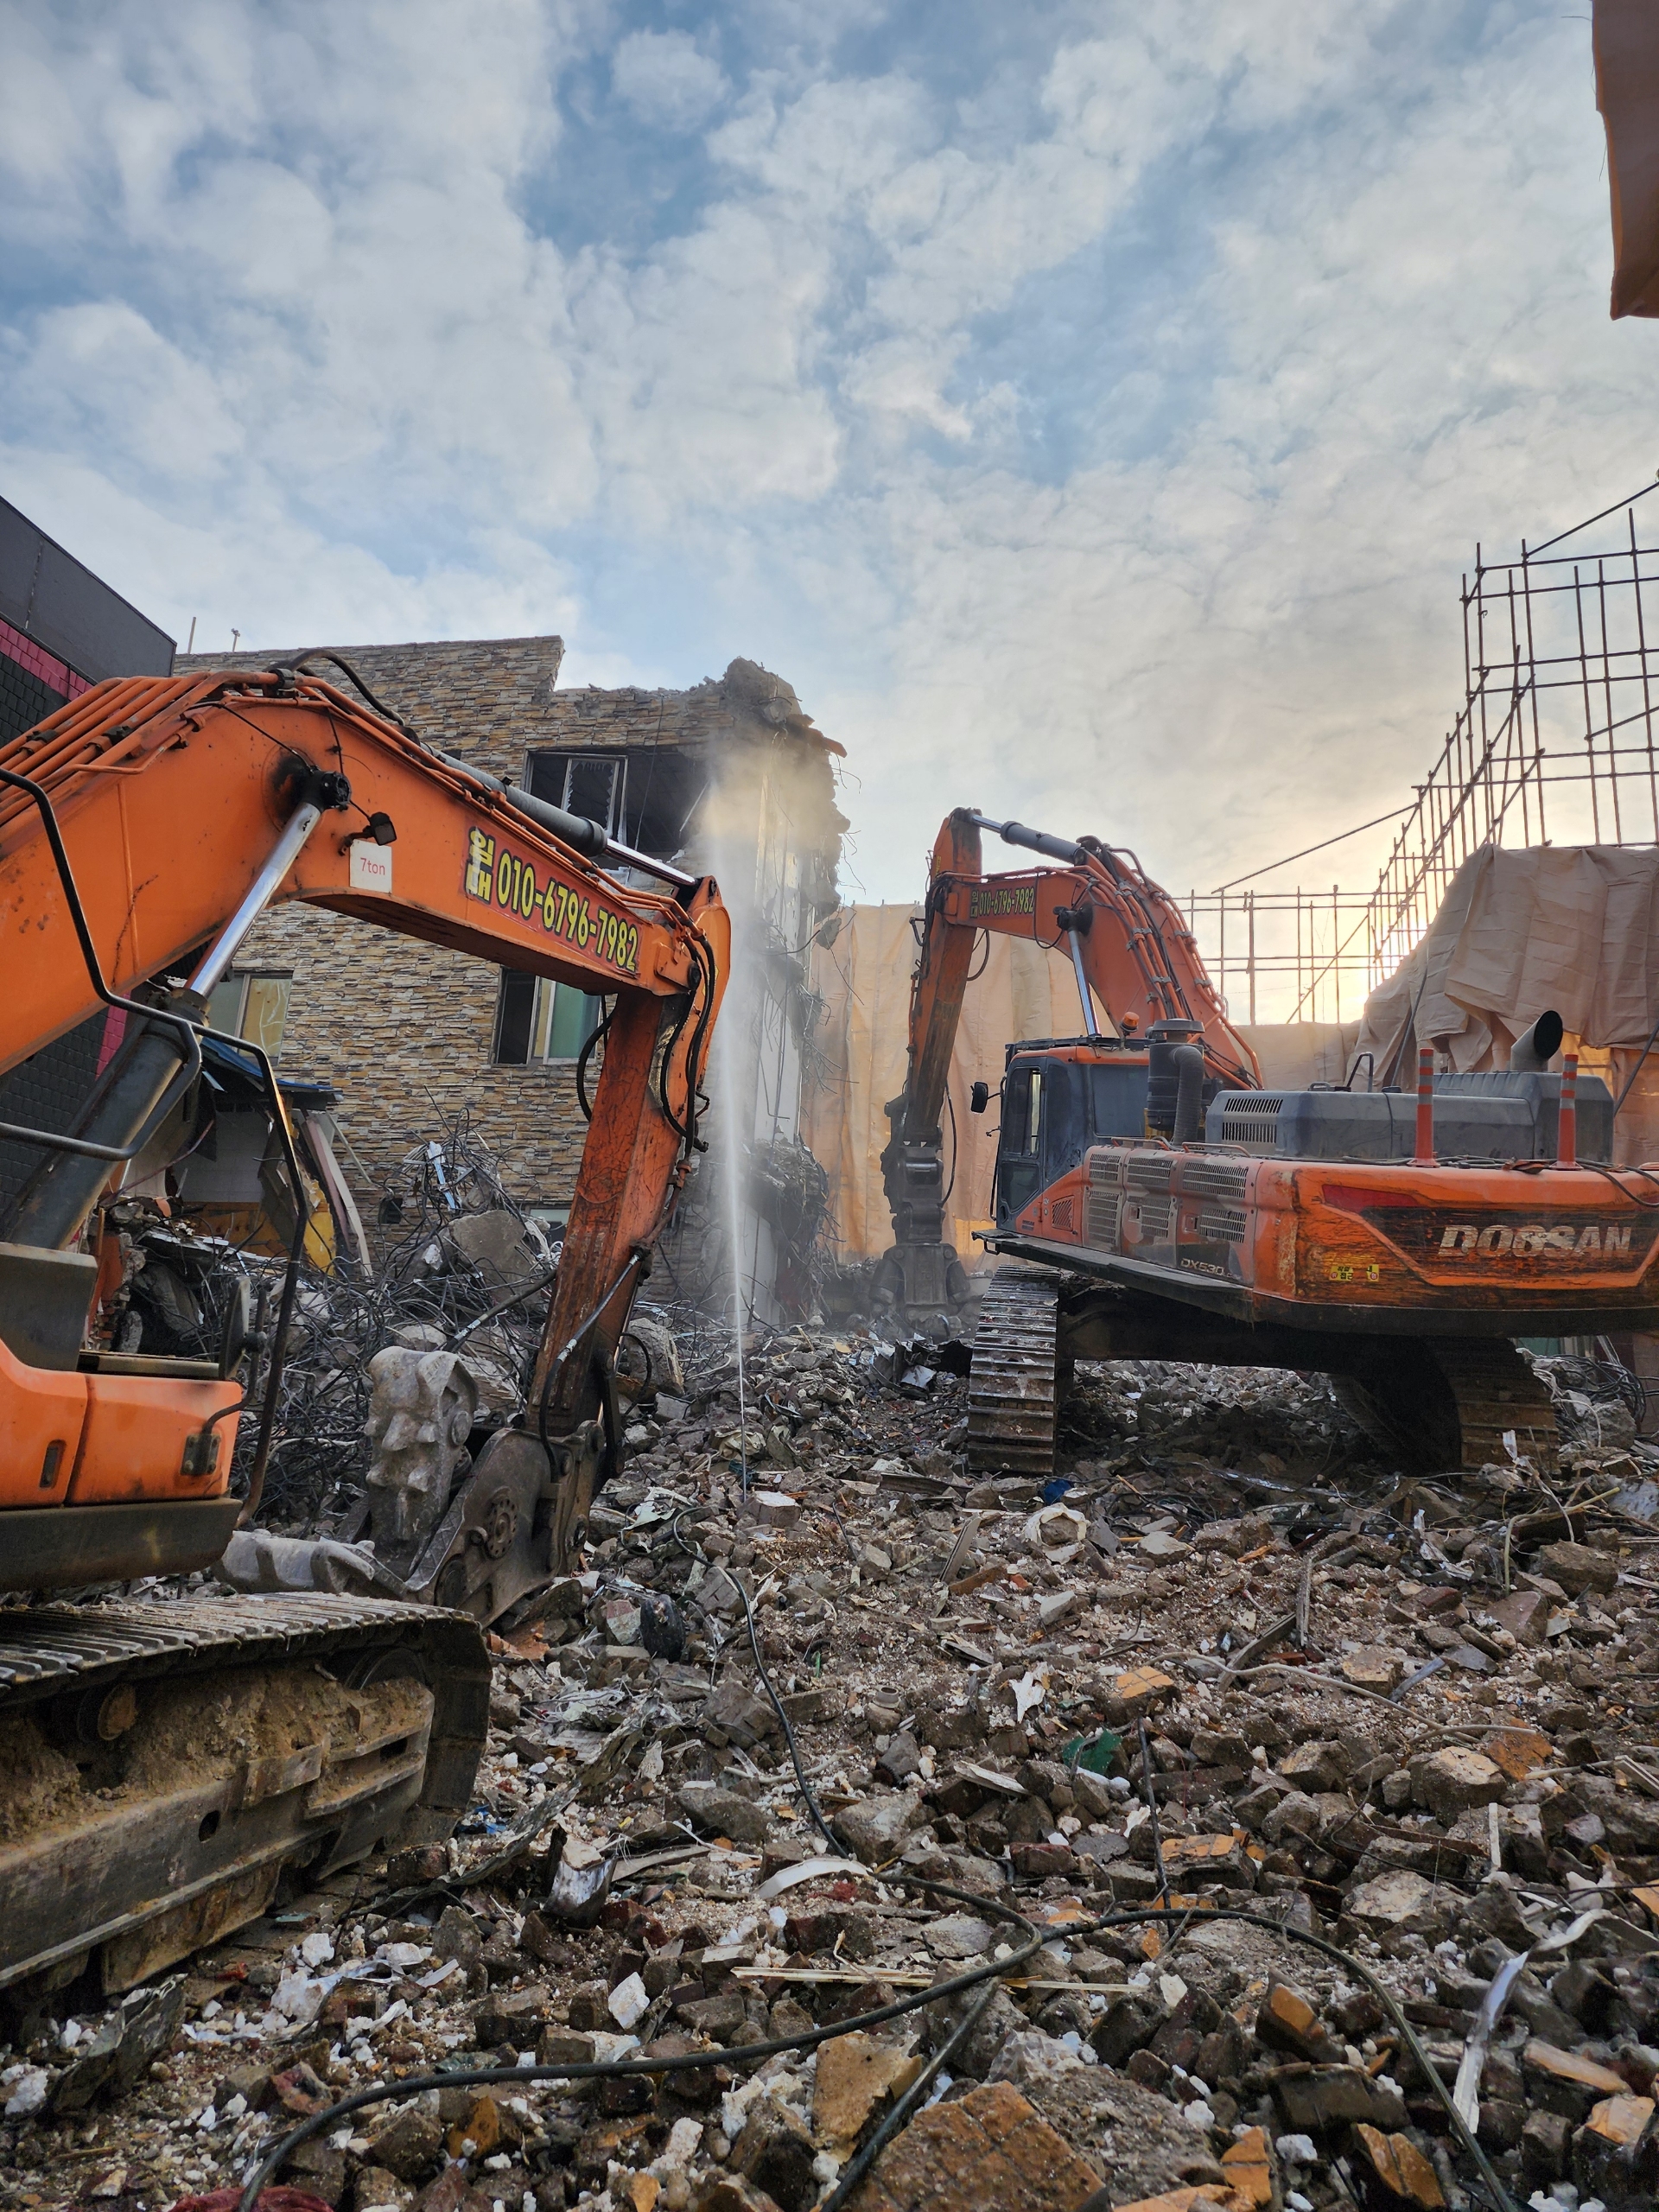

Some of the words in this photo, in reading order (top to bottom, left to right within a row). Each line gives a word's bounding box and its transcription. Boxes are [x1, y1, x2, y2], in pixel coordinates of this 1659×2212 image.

[359, 856, 385, 875] 7ton
[498, 851, 639, 972] 010-6796-7982
[979, 887, 1034, 916] 010-6796-7982
